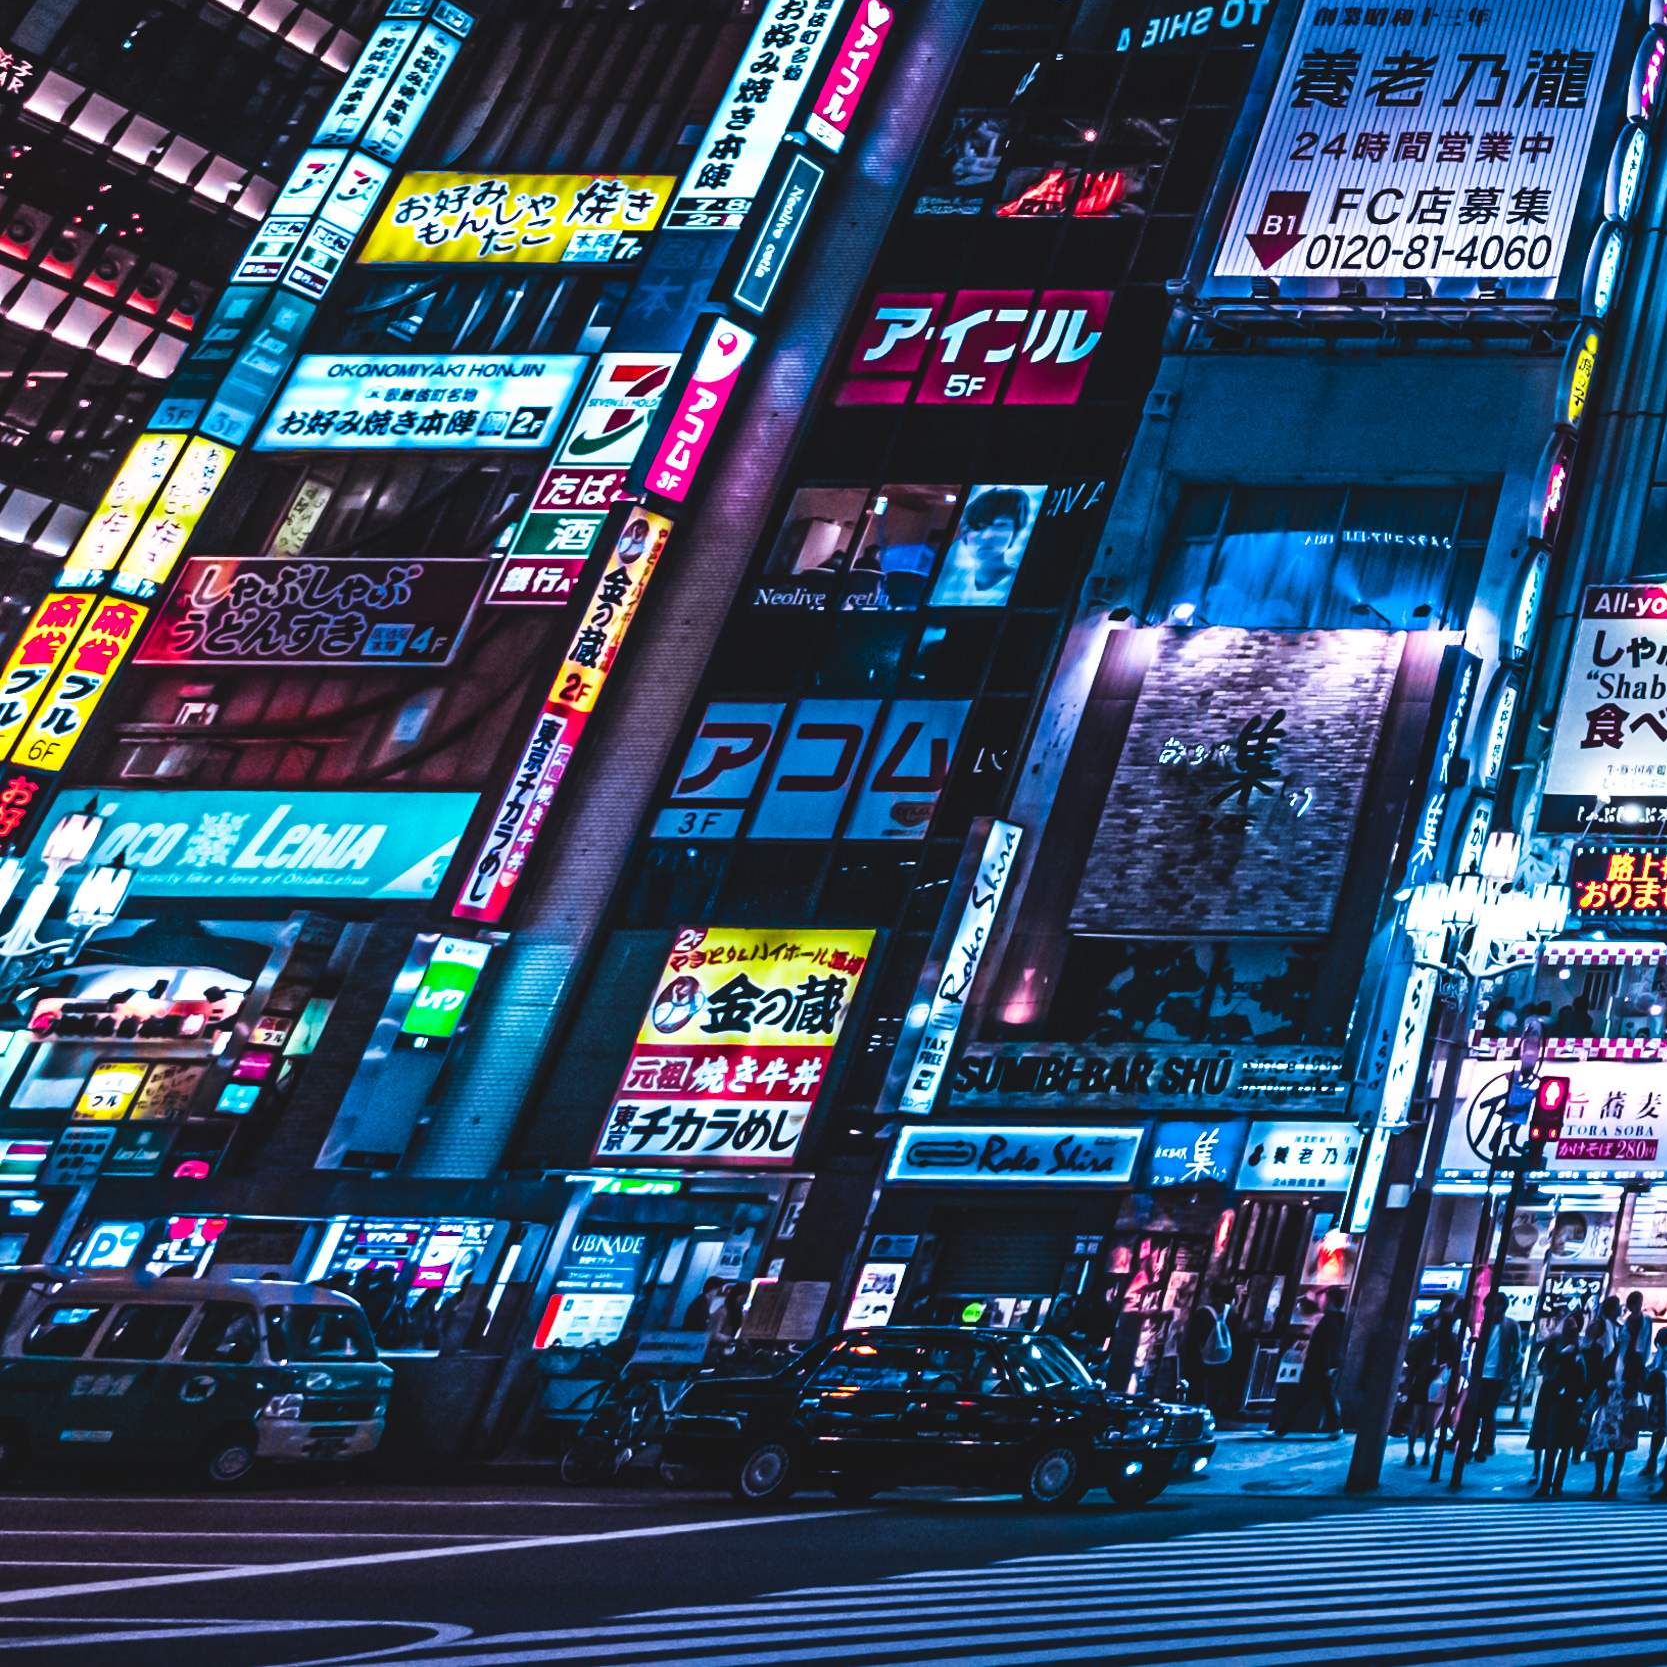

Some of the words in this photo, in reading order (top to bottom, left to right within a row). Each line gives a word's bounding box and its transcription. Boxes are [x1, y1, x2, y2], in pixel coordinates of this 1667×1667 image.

[1291, 47, 1597, 111] 養老乃瀧
[1290, 131, 1555, 166] 24時間営業中
[396, 180, 508, 223] お好み
[565, 179, 658, 227] 焼き
[1327, 187, 1551, 227] FC店募集
[685, 213, 722, 227] 2F
[1262, 213, 1297, 238] B1
[617, 236, 642, 261] 7F
[1305, 234, 1553, 272] 0120-81-4060
[328, 363, 467, 379] OKONOMIYAKI
[470, 363, 547, 379] HONJIN
[943, 374, 987, 400] 5F
[277, 409, 480, 437] お好み焼き本陣
[511, 409, 545, 435] 2F
[665, 386, 718, 471] アコム
[656, 471, 682, 491] 3F
[547, 518, 600, 552] 酒
[190, 562, 412, 611] しゃぶしゃぶ
[166, 611, 363, 656] うどんすき
[568, 565, 634, 669] 金の蔵
[408, 621, 449, 656] 4F
[559, 673, 592, 703] 2F
[28, 738, 61, 762] 6F
[678, 722, 948, 796] アコム
[467, 718, 565, 903] 東京チカラめし
[677, 810, 720, 835] 3F
[674, 928, 705, 951] 2F
[700, 972, 849, 1035] 金の蔵
[917, 1052, 943, 1067] FREE
[924, 1035, 949, 1052] TAX
[627, 1058, 688, 1092] 元祖
[687, 1055, 823, 1096] 焼き牛丼
[601, 1104, 641, 1152] 東京
[629, 1104, 804, 1152] チカラめし
[1566, 1125, 1615, 1137] TORA
[1620, 1125, 1655, 1137] SOBA
[1558, 1141, 1613, 1160] かけそば
[1615, 1140, 1657, 1160] 280円
